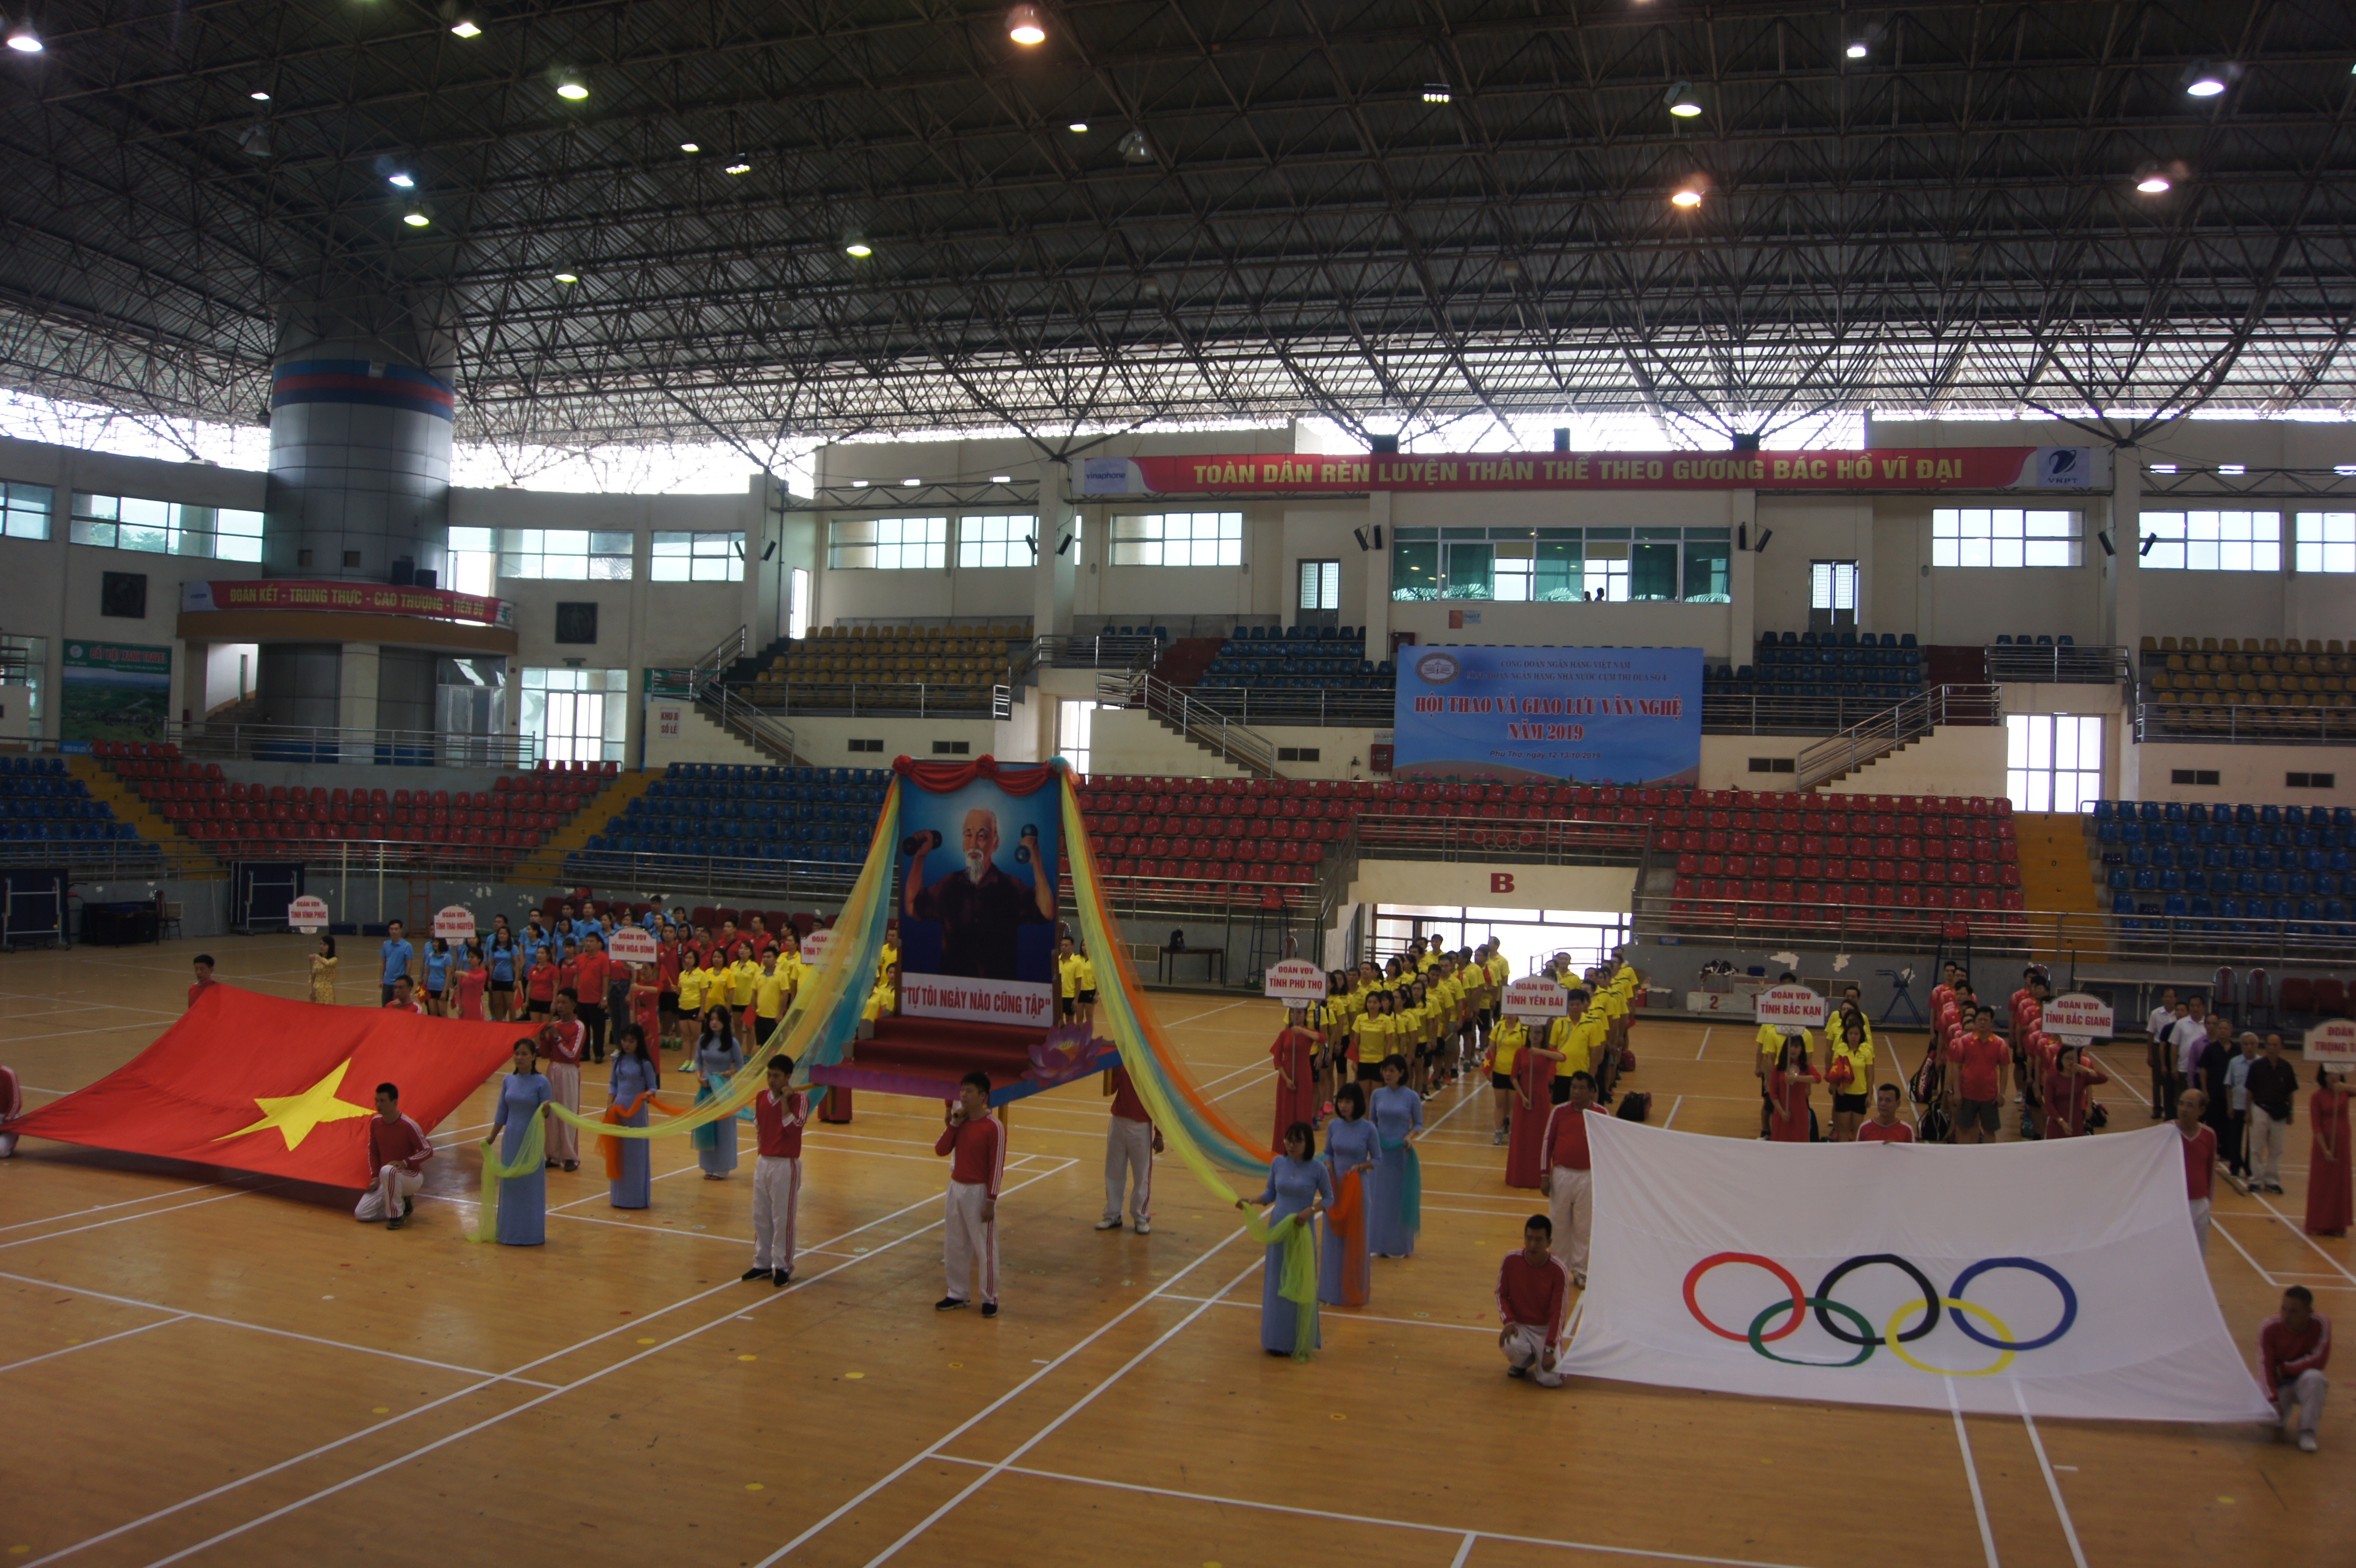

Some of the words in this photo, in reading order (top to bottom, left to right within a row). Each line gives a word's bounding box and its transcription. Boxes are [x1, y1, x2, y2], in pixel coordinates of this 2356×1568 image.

[1194, 460, 1255, 484] TOÀN
[1263, 459, 1312, 483] DÂN
[1320, 458, 1369, 482] RÈN
[1378, 457, 1457, 486] LUYỆN
[1466, 455, 1534, 481] THÂN
[1543, 454, 1590, 481] THỂ
[1599, 460, 1663, 480] THEO
[1673, 458, 1764, 480] GƯƠNG
[1773, 455, 1827, 480] BÁC
[1836, 452, 1873, 480] HỒ
[1883, 455, 1907, 479] VĨ
[1916, 458, 1962, 483] ĐẠI
[1085, 471, 1126, 481] vinaphone
[230, 587, 257, 602] ĐOÀN
[259, 585, 278, 602] KẾT
[289, 588, 328, 603] TRUNG
[332, 589, 362, 606] THỰC
[374, 592, 397, 607] CAO
[401, 593, 443, 612] THƯỢNG
[453, 595, 472, 614] TIẾN
[473, 599, 484, 618] BỘ
[106, 647, 121, 662] VIỆT
[122, 650, 142, 662] XANH
[143, 652, 167, 663] TRAVEL
[1501, 659, 1522, 668] CÔNG
[1524, 659, 1545, 669] ĐOÀN
[1547, 659, 1568, 669] NGÂN
[1570, 659, 1592, 669] HÀNG
[1593, 659, 1612, 670] VIỆT
[1488, 672, 1508, 680] ĐOÀN
[1511, 671, 1533, 680] NGÂN
[1534, 671, 1555, 680] HÀNG
[1557, 671, 1574, 680] NHÀ
[1575, 671, 1597, 680] NƯỚC
[1599, 673, 1617, 682] CỤM
[1618, 673, 1631, 681] THI
[1633, 673, 1648, 681] ĐUA
[1651, 671, 1661, 681] SỐ
[1414, 692, 1444, 718] HỘI
[1448, 696, 1492, 713] THAO
[1496, 692, 1518, 714] VÀ
[1521, 697, 1562, 715] GIAO
[1565, 695, 1597, 715] LƯU
[1601, 694, 1635, 716] VĂN
[1637, 695, 1683, 721] NGHỆ
[661, 712, 673, 720] KHU
[661, 723, 669, 733] SỐ
[1507, 719, 1543, 740] NĂM
[1547, 723, 1584, 741] 2019
[1526, 751, 1545, 759] ngày
[1548, 751, 1601, 759] 12-13/10/2019
[1490, 873, 1515, 893] B
[291, 909, 301, 918] TỈNH
[436, 920, 445, 929] TỈNH
[457, 920, 474, 929] NGUYÊN
[612, 941, 625, 951] TỈNH
[640, 944, 654, 953] BÌNH
[803, 945, 815, 955] TỈNH
[1278, 965, 1298, 973] ĐOÀN
[1269, 975, 1287, 987] TỈNH
[1289, 977, 1305, 988] PHÚ
[1308, 980, 1322, 991] THỌ
[1516, 982, 1537, 990] ĐOÀN
[1506, 992, 1526, 1005] TỈNH
[1529, 994, 1546, 1006] YÊN
[1548, 995, 1563, 1007] BÁI
[1772, 990, 1793, 999] ĐOÀN
[902, 986, 920, 1008] "TỰ
[922, 985, 937, 1006] TÔI
[940, 987, 966, 1009] NGÀY
[969, 989, 990, 1011] NÀO
[994, 991, 1022, 1014] CŨNG
[1025, 993, 1050, 1019] TẬP"
[1710, 995, 1718, 1010] 2
[2058, 1000, 2080, 1009] ĐOÀN
[1761, 1002, 1780, 1014] TỈNH
[1783, 1002, 1800, 1014] BẮC
[1803, 1006, 1821, 1017] KẠN
[2045, 1010, 2064, 1024] TỈNH
[2067, 1011, 2083, 1025] BẮC
[2085, 1016, 2111, 1027] GIANG
[2327, 1025, 2355, 1037] ĐOÀN
